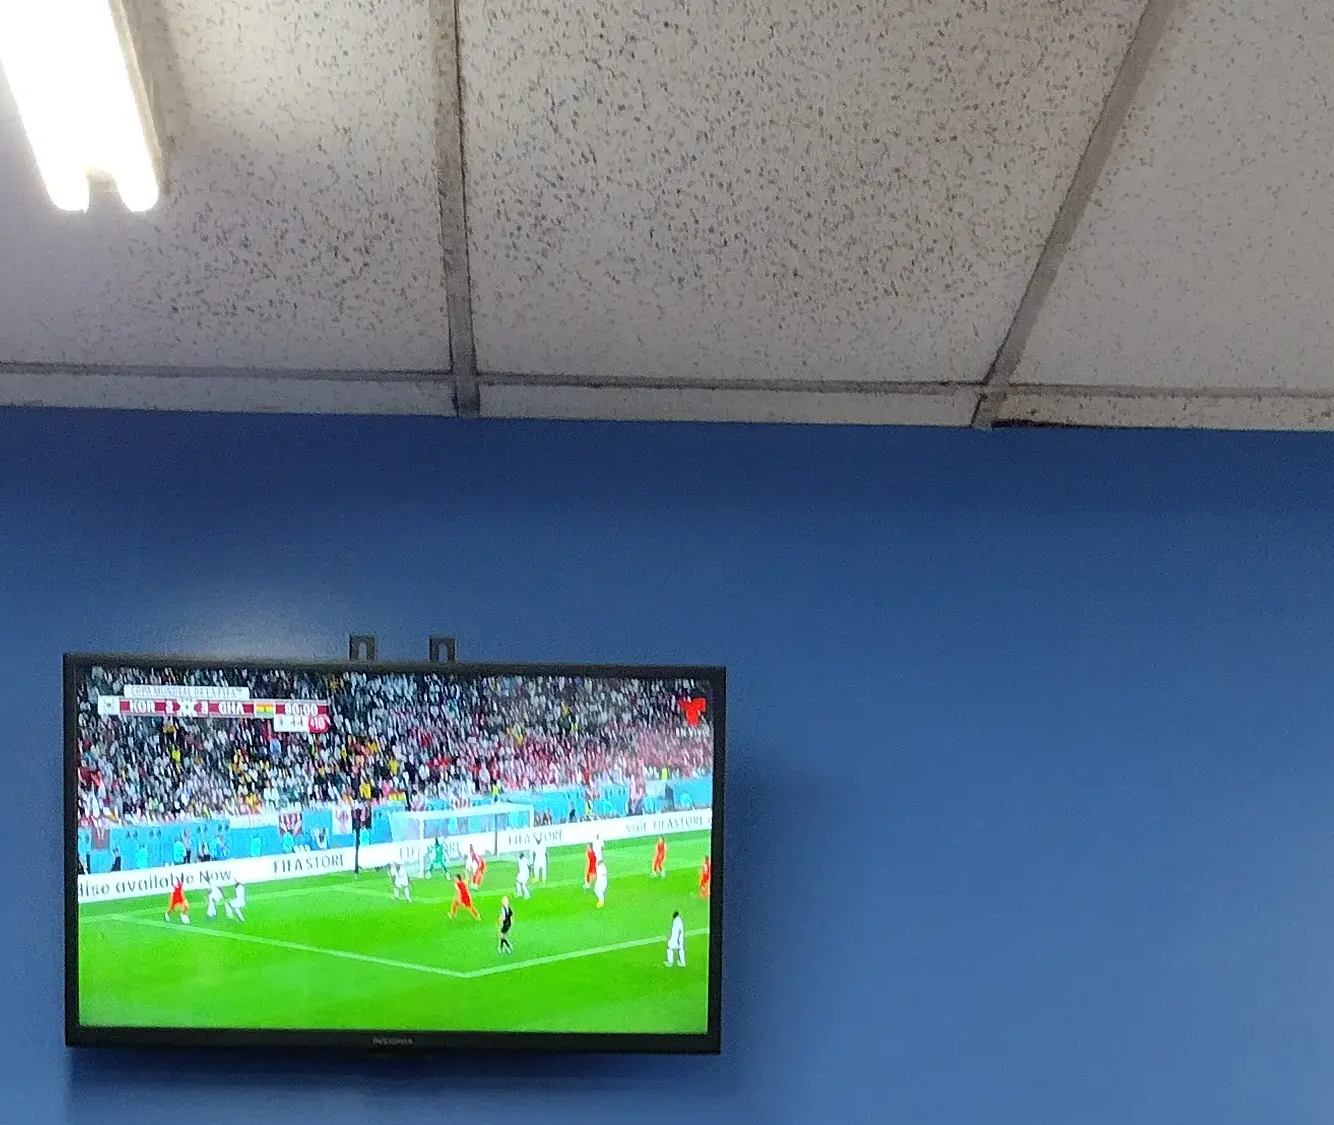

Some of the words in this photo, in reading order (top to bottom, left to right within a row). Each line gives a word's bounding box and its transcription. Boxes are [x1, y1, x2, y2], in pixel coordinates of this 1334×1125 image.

[130, 701, 155, 713] KOR
[218, 703, 245, 715] GHA
[274, 858, 303, 873] FIFA
[307, 854, 344, 869] STORE
[116, 872, 195, 893] available
[199, 869, 232, 883] Now
